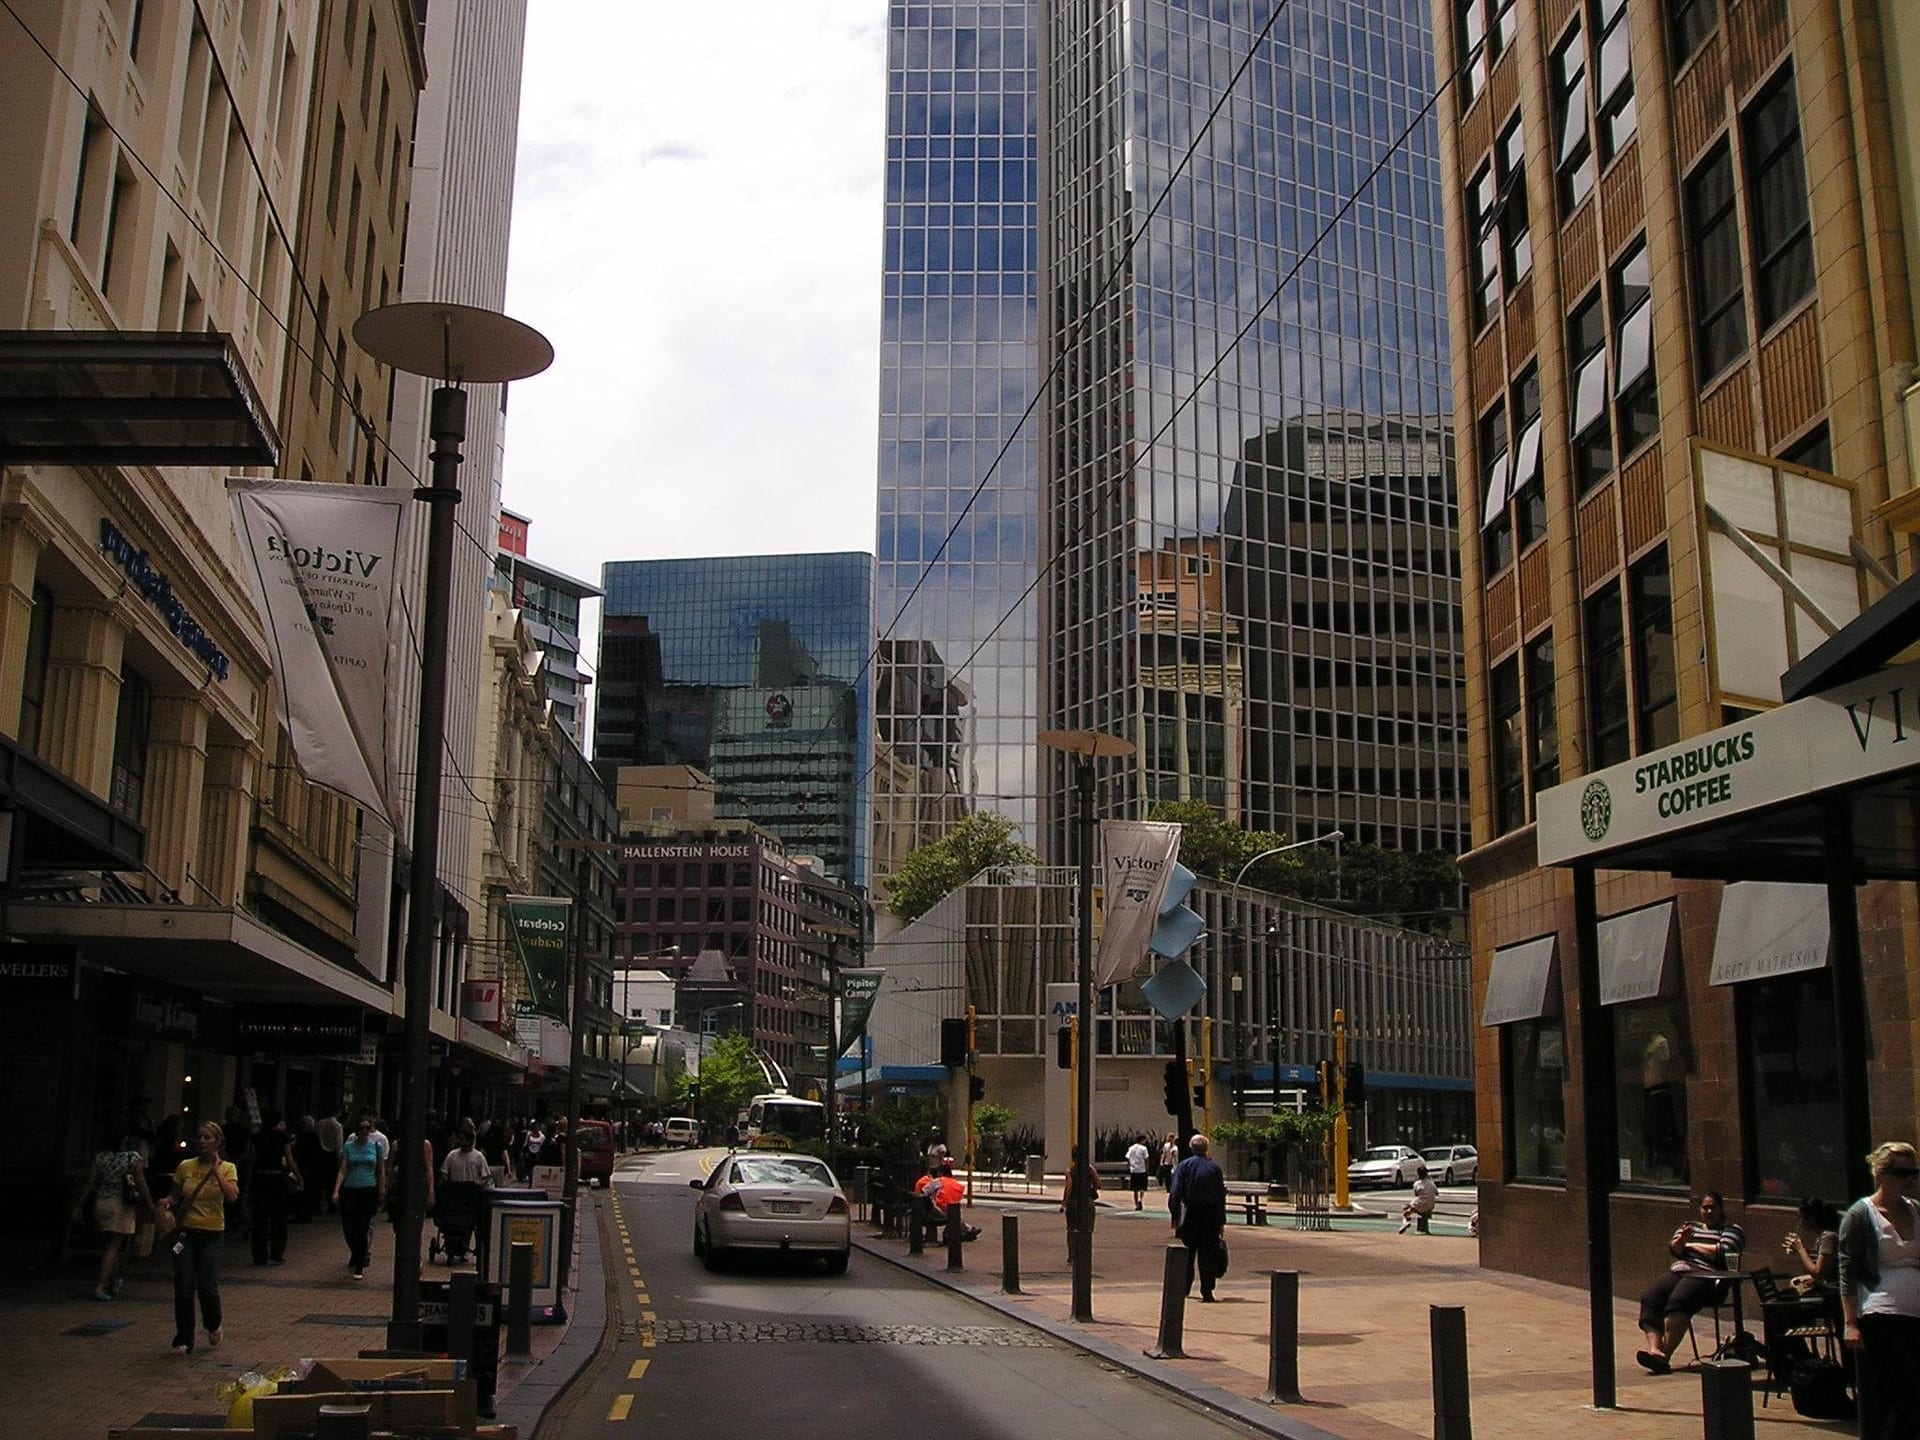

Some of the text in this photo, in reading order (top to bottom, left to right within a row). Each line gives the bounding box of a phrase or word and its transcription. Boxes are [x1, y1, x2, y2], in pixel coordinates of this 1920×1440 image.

[1844, 687, 1911, 752] VI
[1635, 731, 1755, 794] STARBUCKS
[1658, 774, 1732, 818] COFFEE
[624, 845, 750, 859] HALLENSTEIN HOUSE
[1052, 1001, 1077, 1015] AN
